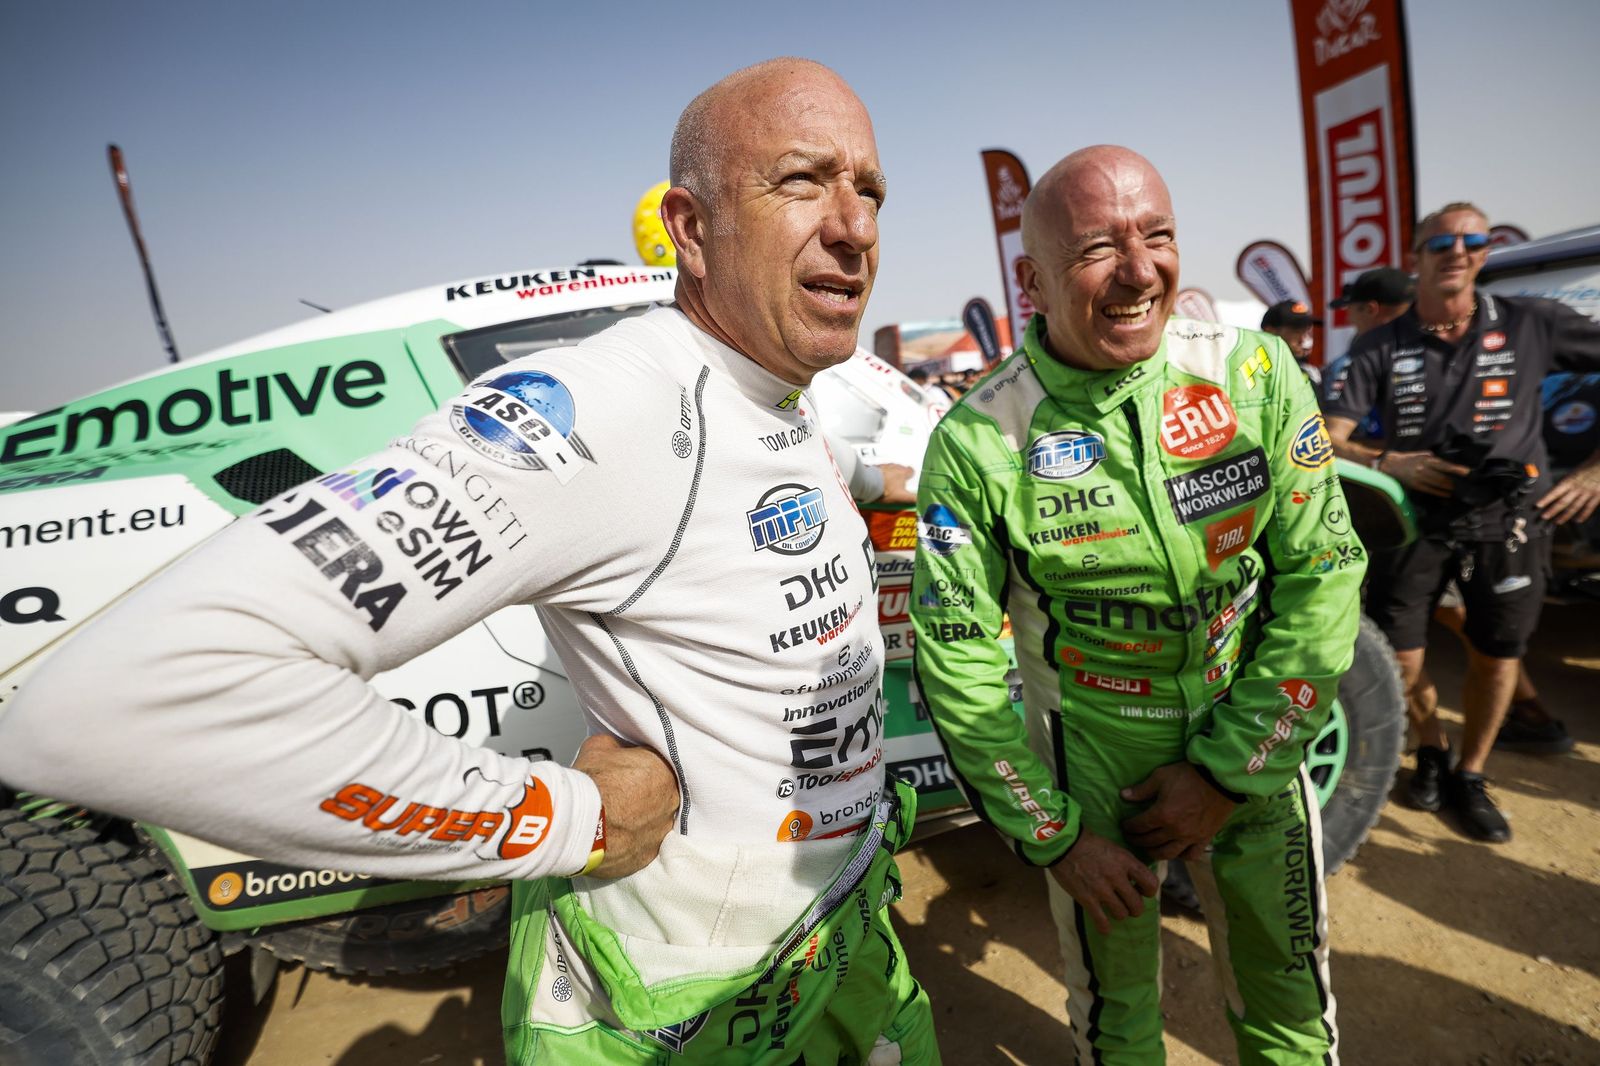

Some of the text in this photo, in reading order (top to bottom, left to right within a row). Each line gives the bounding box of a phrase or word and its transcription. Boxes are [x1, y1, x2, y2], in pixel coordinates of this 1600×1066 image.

[446, 268, 597, 302] KEUKEN
[472, 392, 552, 442] ASC
[1161, 393, 1231, 449] ERU
[758, 431, 790, 452] TOM
[1205, 432, 1226, 446] 1824
[1037, 485, 1115, 519] DHG
[1178, 475, 1265, 516] WORKWEAR
[404, 481, 493, 577] OWN
[782, 542, 792, 550] OIL
[926, 526, 953, 542] ASC
[1028, 521, 1100, 546] KEUKEN
[1215, 526, 1245, 554] JBL
[376, 510, 464, 601] eSIM
[780, 553, 849, 611] DHG
[770, 604, 848, 653] KEUKEN
[1120, 706, 1143, 718] TIM
[319, 782, 504, 843] SUPER
